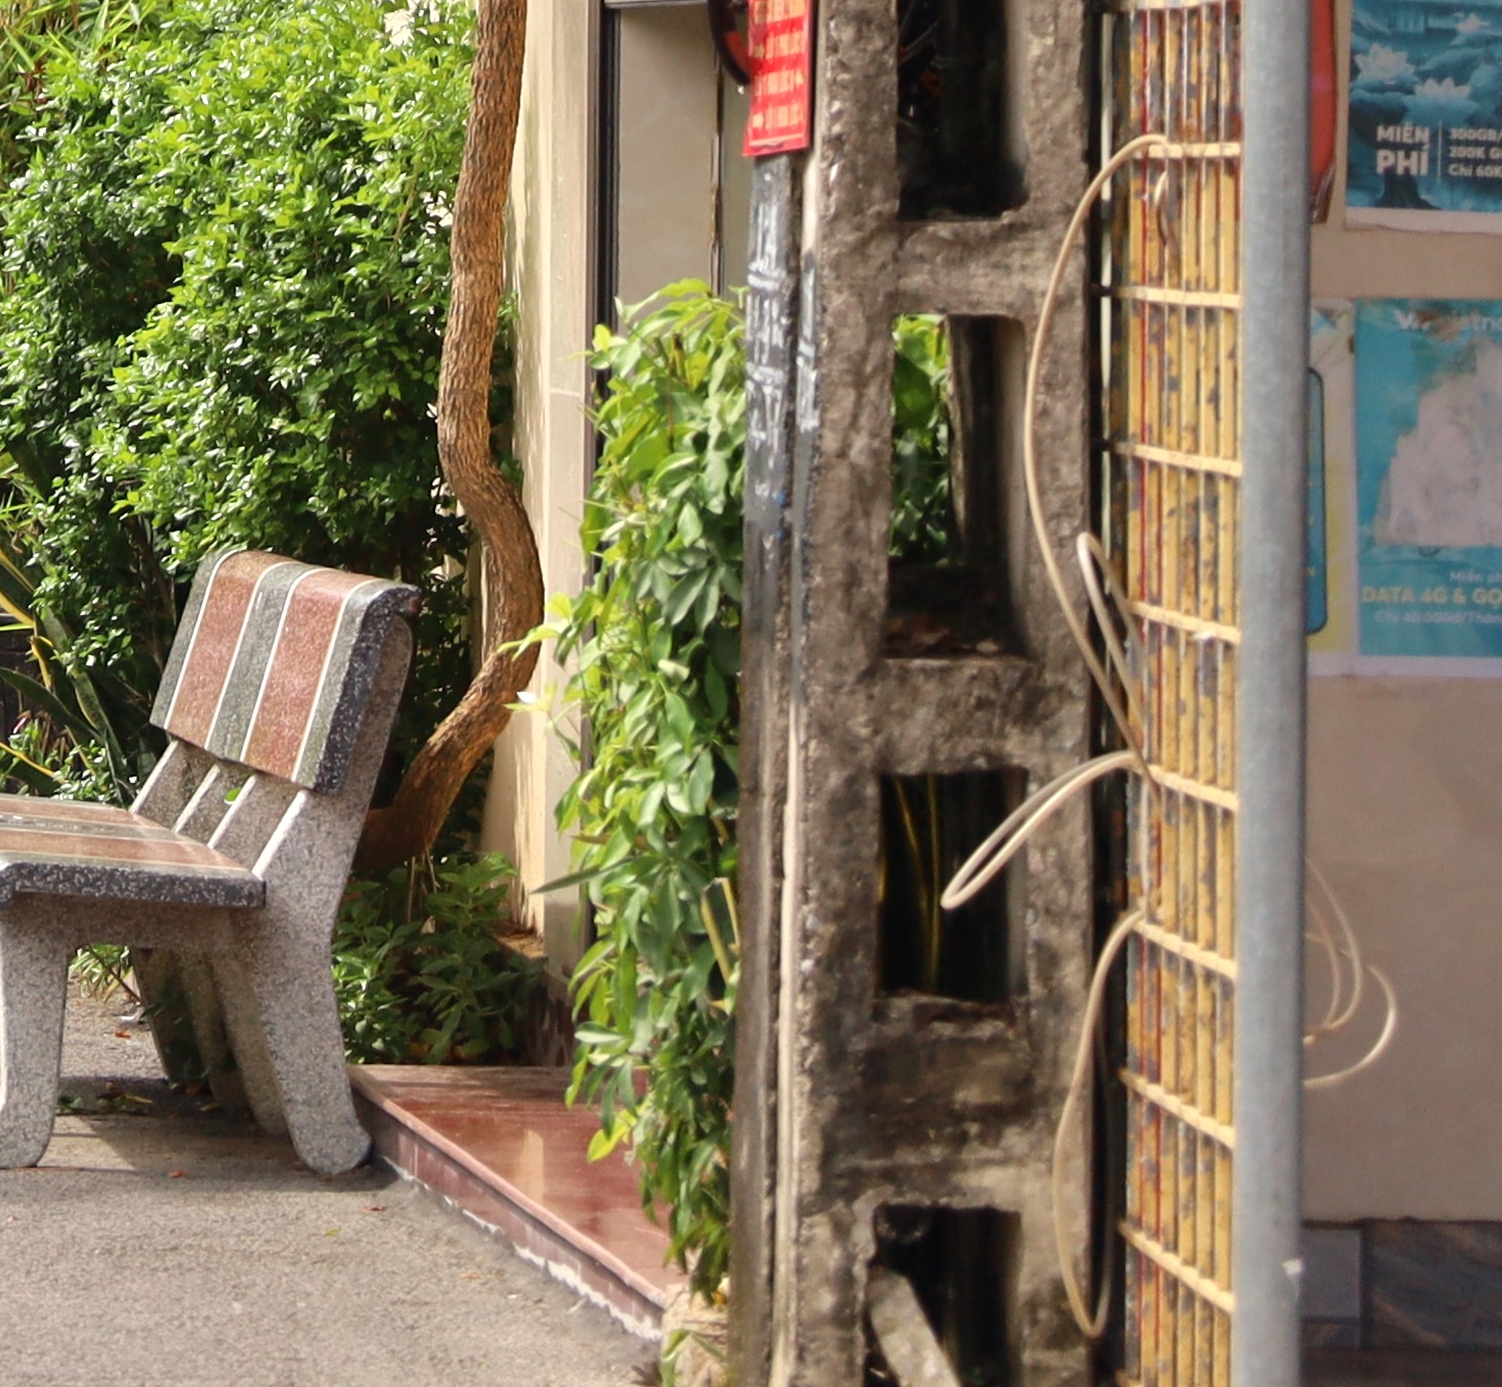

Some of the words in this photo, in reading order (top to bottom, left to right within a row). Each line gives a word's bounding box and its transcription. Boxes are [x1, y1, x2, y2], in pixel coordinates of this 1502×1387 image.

[1376, 144, 1430, 176] PHÍ
[1362, 586, 1414, 604] DATA
[1421, 586, 1448, 604] 4G
[1453, 587, 1467, 604] &
